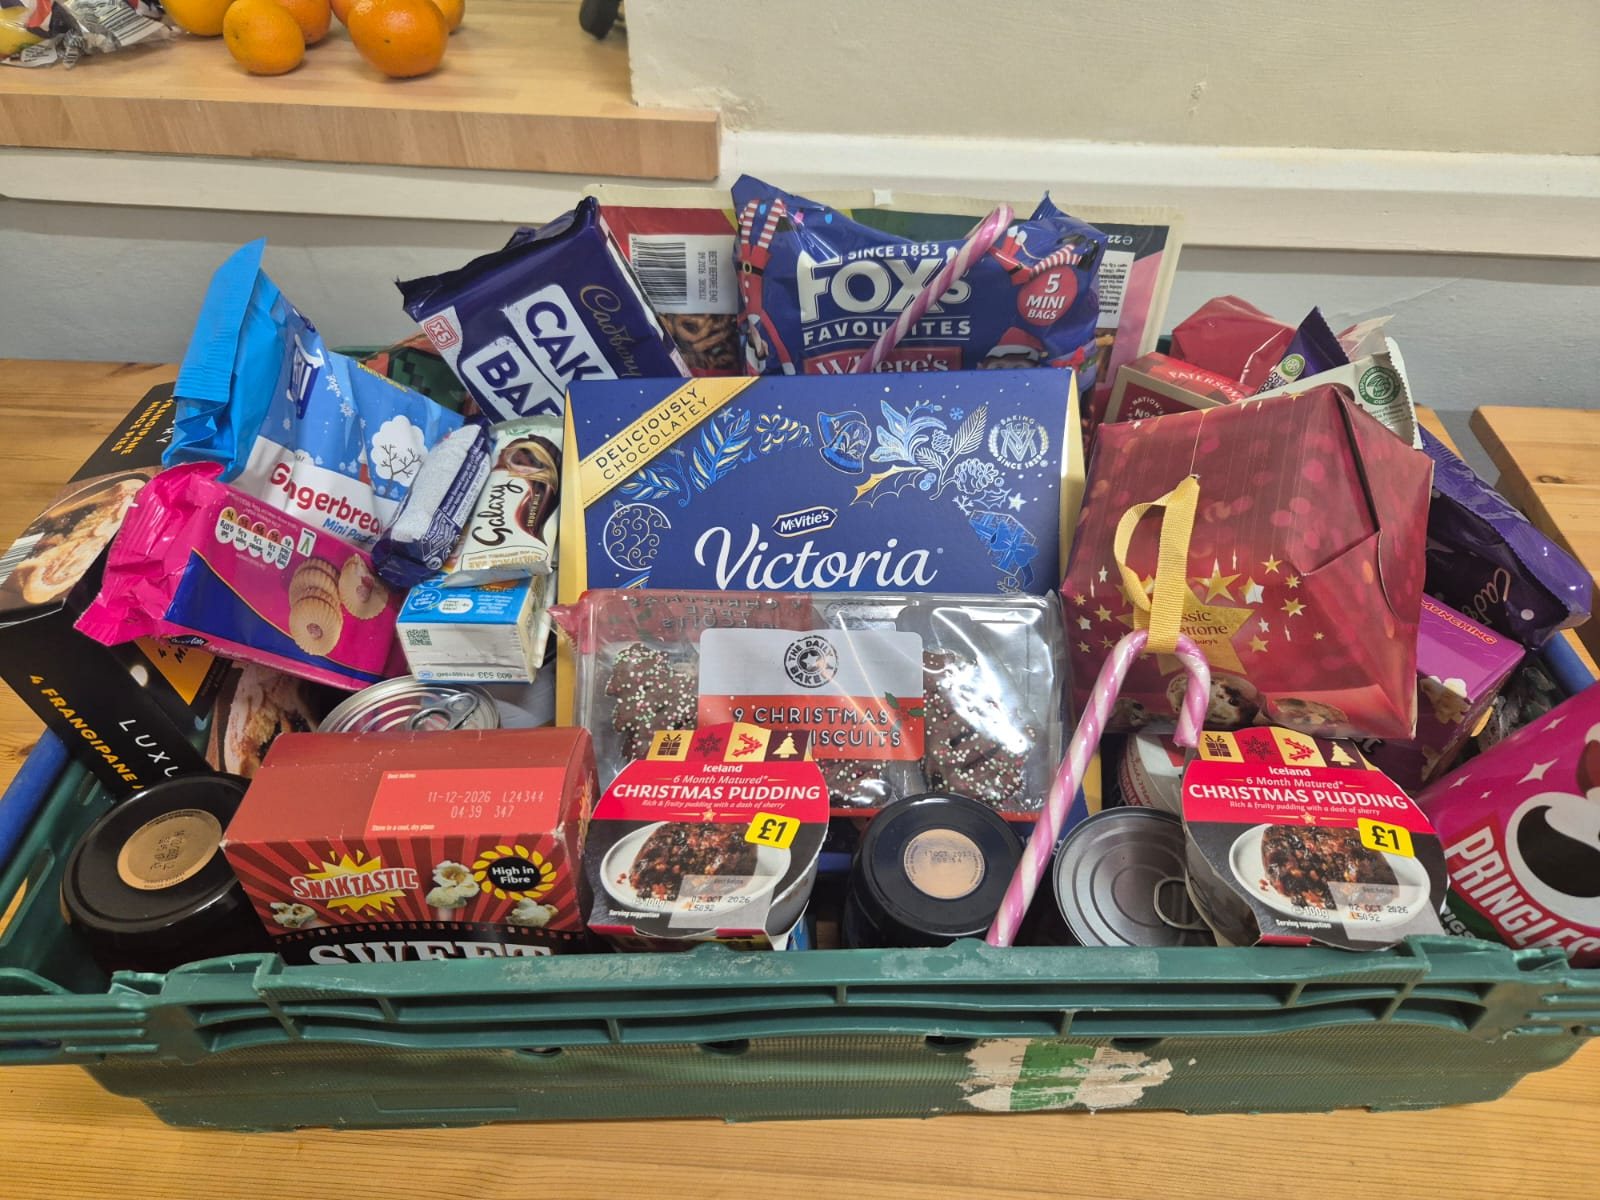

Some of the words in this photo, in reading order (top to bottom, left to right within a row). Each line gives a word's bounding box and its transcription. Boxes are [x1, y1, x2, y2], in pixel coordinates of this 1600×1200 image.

[847, 245, 894, 260] SINCE
[901, 243, 940, 257] 1853
[1044, 273, 1062, 294] 5
[1026, 295, 1065, 309] MINI
[1027, 309, 1057, 320] BAGS
[526, 301, 604, 380] CAK
[803, 320, 971, 346] FAVOUITES
[816, 354, 948, 375] Were's
[476, 350, 562, 417] BA
[595, 387, 698, 469] DELICIOUSLY
[1000, 415, 1036, 425] BAKING
[603, 397, 708, 480] CHOCOLATEY
[997, 455, 1022, 470] SINCE
[270, 463, 383, 535] Gngerbrea
[472, 479, 524, 546] Galaxy
[780, 510, 830, 532] McVitie's
[323, 518, 348, 536] Mini
[694, 523, 938, 591] Victoria
[1181, 610, 1211, 622] ssic
[1180, 625, 1228, 635] ettone
[788, 645, 803, 663] THE
[805, 640, 834, 658] DAILY
[734, 708, 745, 723] 9
[754, 707, 889, 724] CHRISTMAS
[29, 675, 45, 685] 4
[41, 688, 138, 782] FRANGIPANE
[811, 730, 901, 747] ISCUITS
[118, 719, 180, 778] LUX
[703, 764, 742, 773] Iceland
[1268, 766, 1311, 777] Iceland
[673, 775, 681, 784] 6
[682, 775, 715, 784] Month
[1246, 777, 1253, 785] 6
[1256, 777, 1291, 787] Month
[428, 791, 492, 803] 11-12-2026
[502, 790, 544, 803] L24344
[612, 784, 723, 800] CHRISTMAS
[728, 785, 820, 800] PUDDING
[1188, 784, 1310, 804] CHRISTMAS
[1312, 789, 1408, 810] PUDDING
[493, 806, 515, 818] 347
[664, 800, 683, 809] fruity
[684, 801, 712, 809] pudding
[763, 801, 786, 810] sherry
[1230, 800, 1246, 808] Rich
[1253, 801, 1275, 811] fruity
[1276, 803, 1305, 812] pudding
[1330, 805, 1347, 813] dash
[1357, 807, 1380, 816] sherry
[757, 818, 788, 843] £1
[1370, 824, 1401, 851] £1
[491, 865, 519, 877] High
[521, 866, 535, 875] in
[500, 874, 531, 884] Fibre
[291, 867, 419, 899] SNAKTASTIC
[727, 895, 751, 904] 2026
[1275, 919, 1299, 928] Serving
[1299, 921, 1332, 929] suggestion
